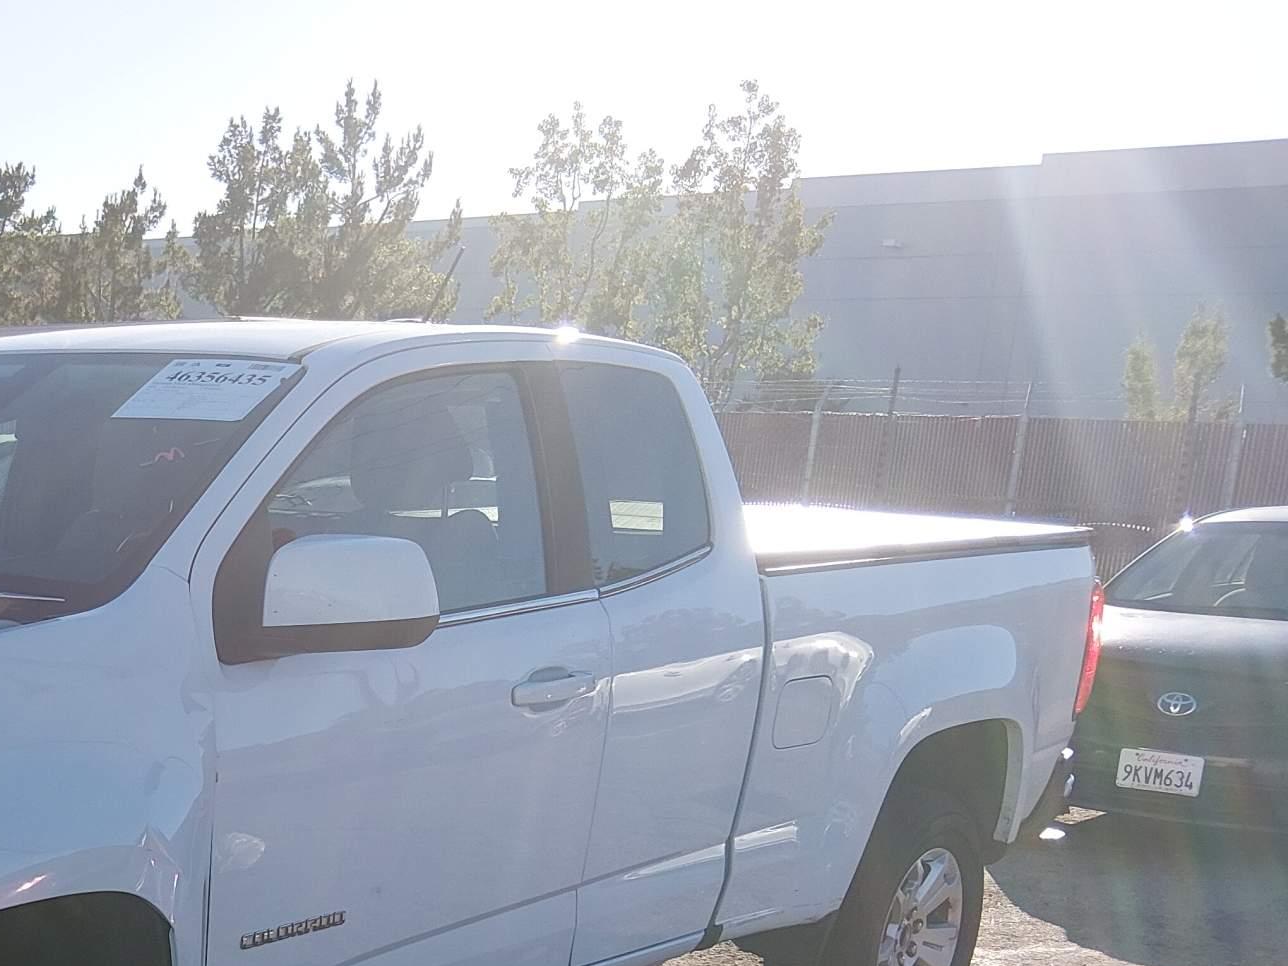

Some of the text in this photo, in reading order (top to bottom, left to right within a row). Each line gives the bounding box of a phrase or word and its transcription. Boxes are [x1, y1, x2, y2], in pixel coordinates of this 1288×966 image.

[166, 370, 273, 386] 46356435
[1136, 753, 1184, 768] California
[1122, 764, 1193, 790] 9KVM634
[240, 910, 347, 950] COLORADO
